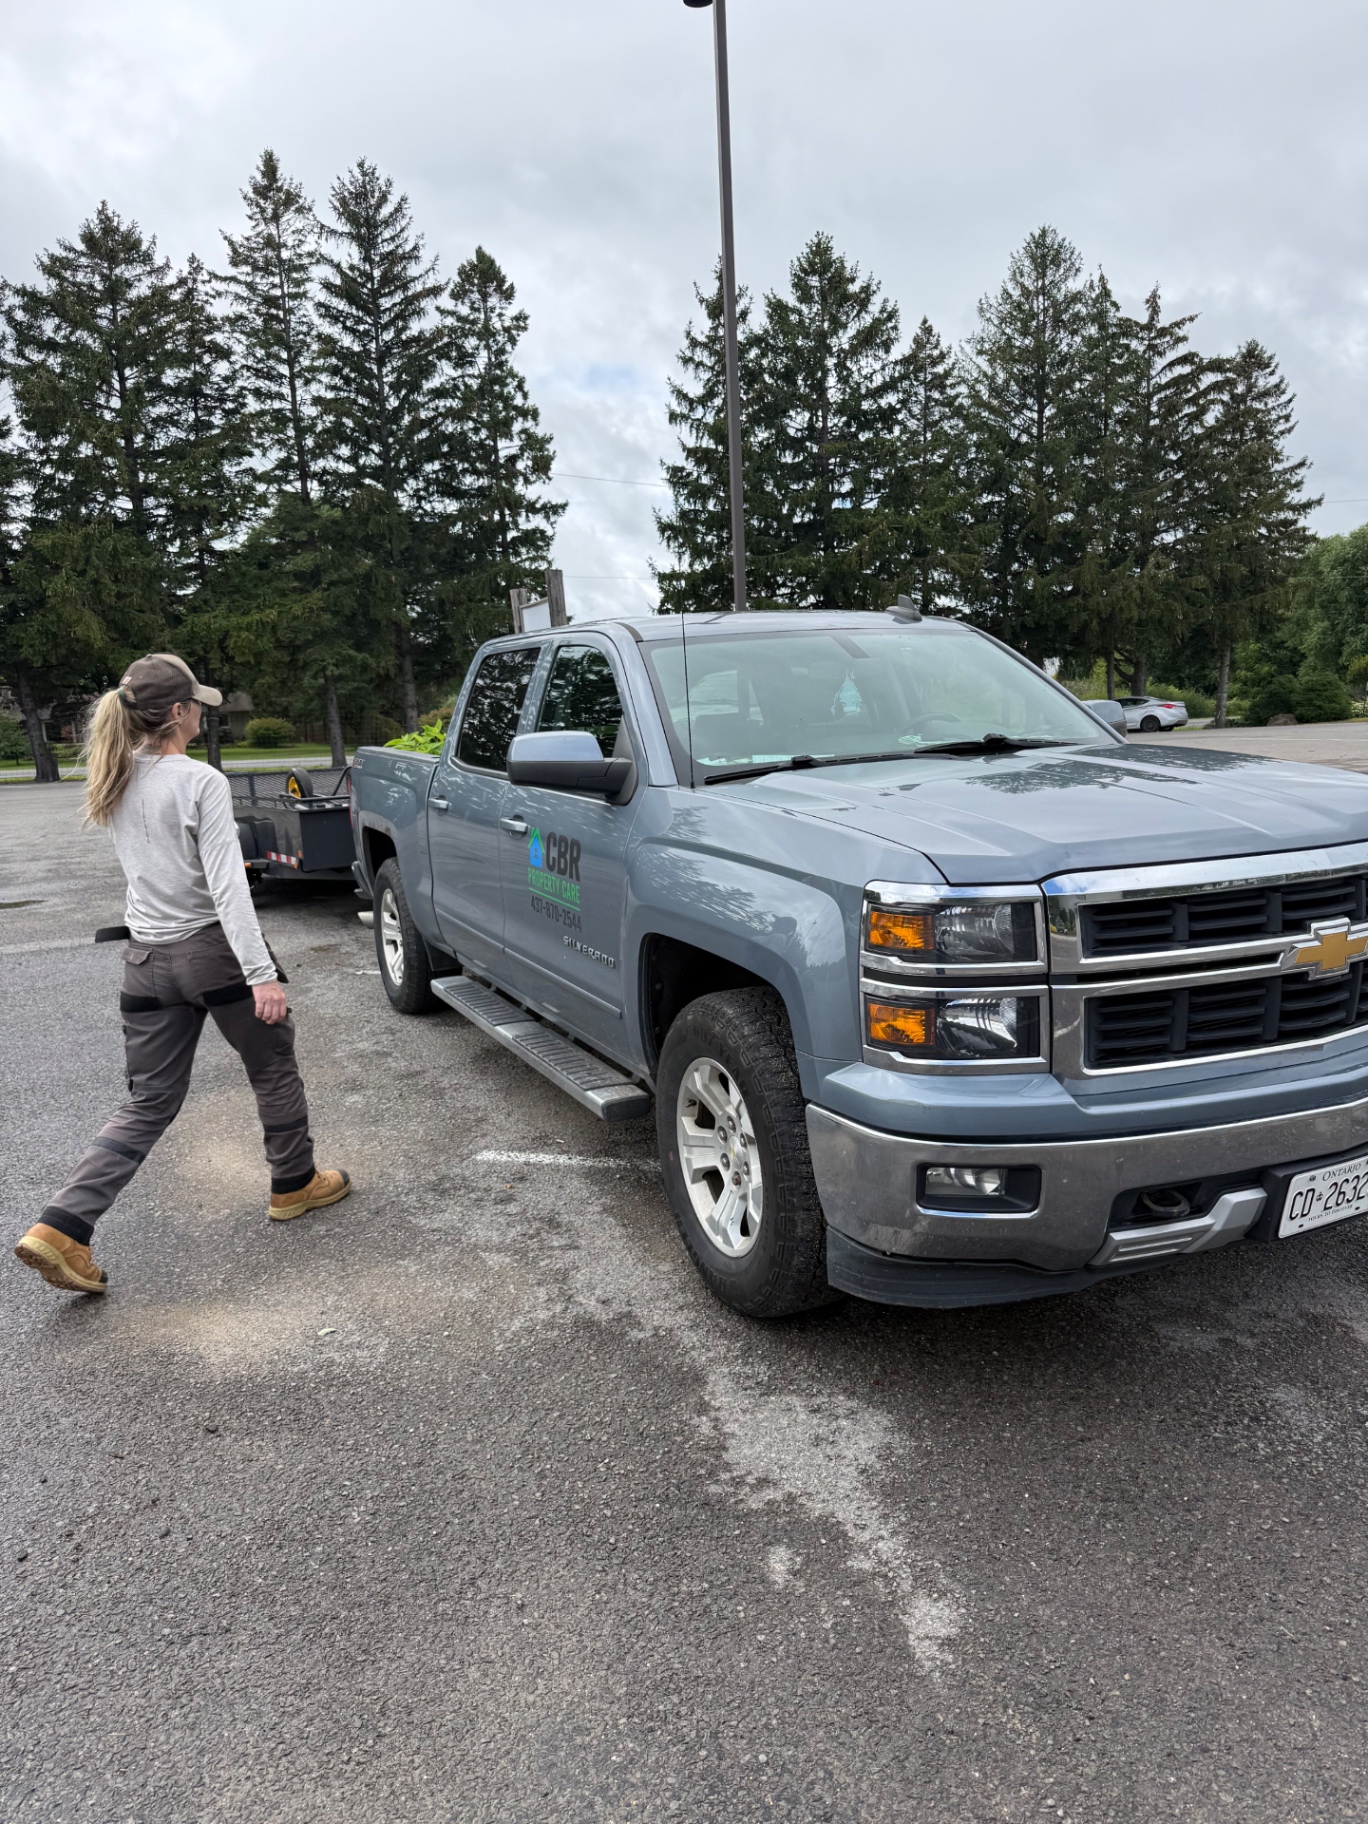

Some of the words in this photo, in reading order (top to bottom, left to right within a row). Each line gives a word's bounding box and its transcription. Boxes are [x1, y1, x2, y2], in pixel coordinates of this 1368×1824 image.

[546, 831, 581, 882] CBR
[528, 867, 561, 895] PROPERTY
[562, 880, 580, 904] CARE
[531, 895, 582, 932] 437-870-2544
[563, 935, 616, 969] SILVERADO
[1322, 1163, 1362, 1182] ONTARIO
